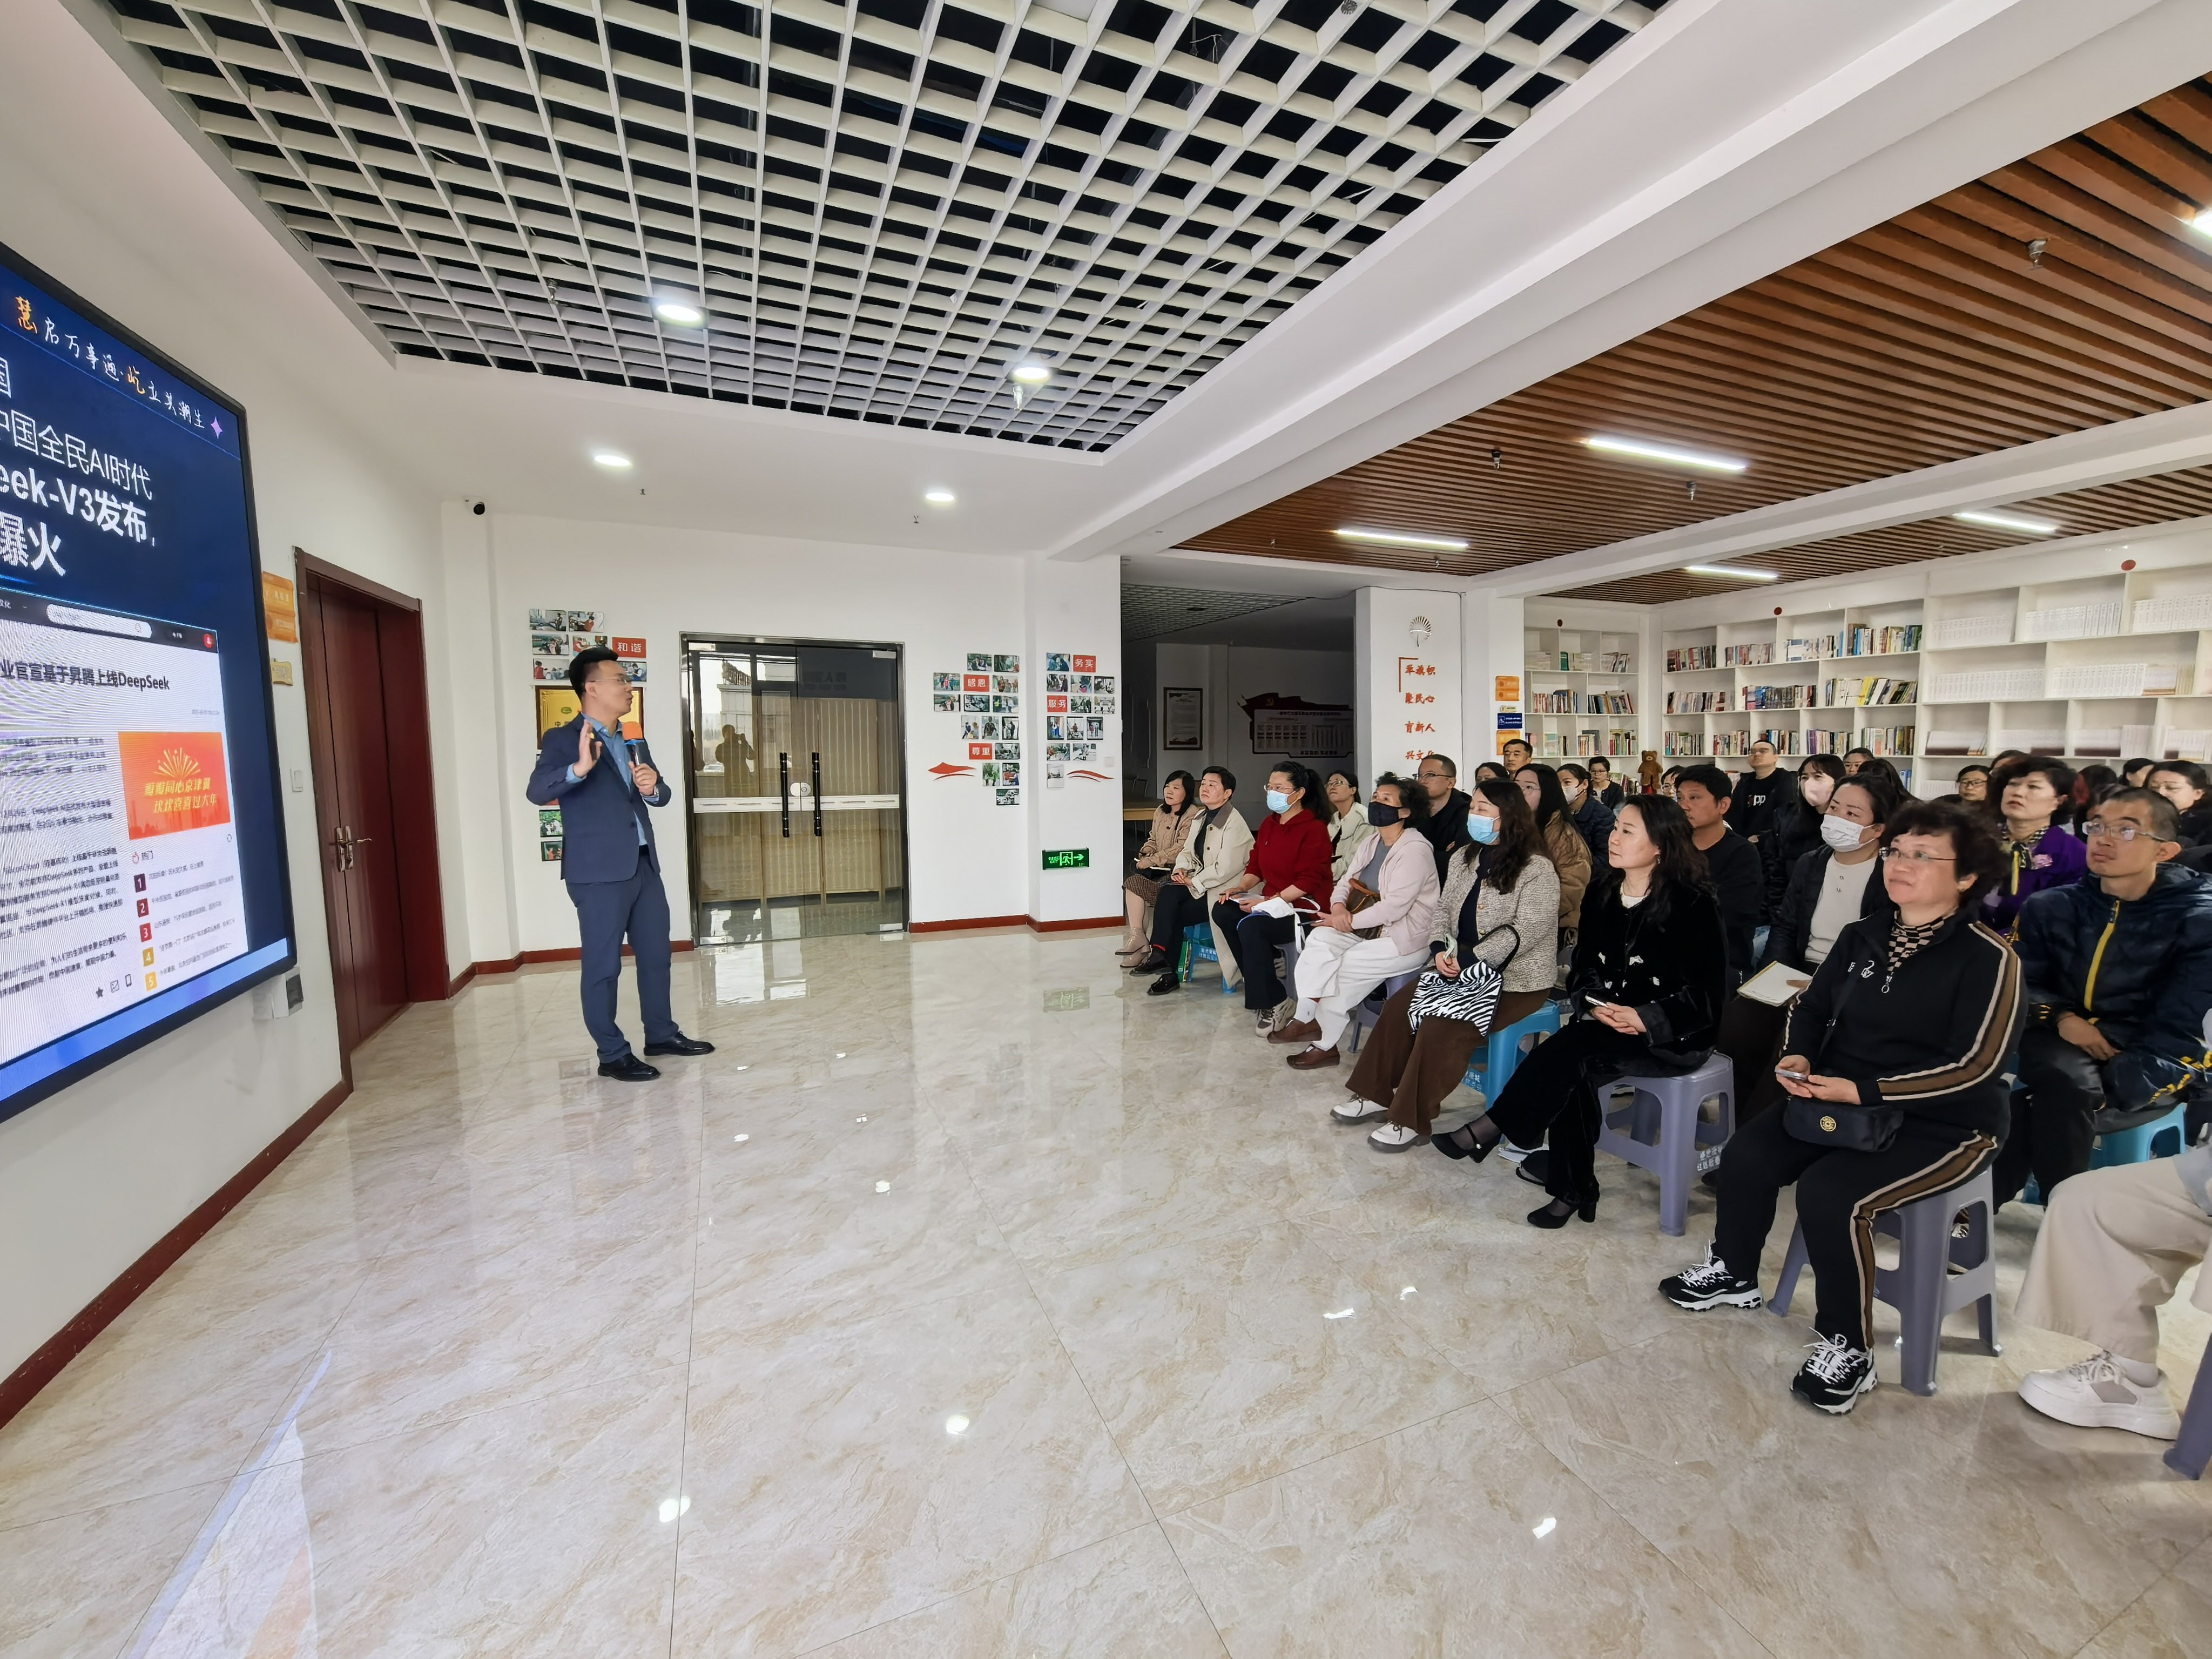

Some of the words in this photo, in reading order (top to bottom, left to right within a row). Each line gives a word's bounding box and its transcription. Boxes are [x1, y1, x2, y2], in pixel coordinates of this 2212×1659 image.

[617, 642, 642, 652] 和谐
[1075, 658, 1094, 668] 务实
[1048, 699, 1067, 708] 服务
[1405, 720, 1435, 733] 育新人
[138, 878, 142, 888] 1
[140, 903, 145, 913] 2
[143, 927, 148, 938] 3
[146, 952, 151, 961] 4
[149, 976, 154, 984] 5
